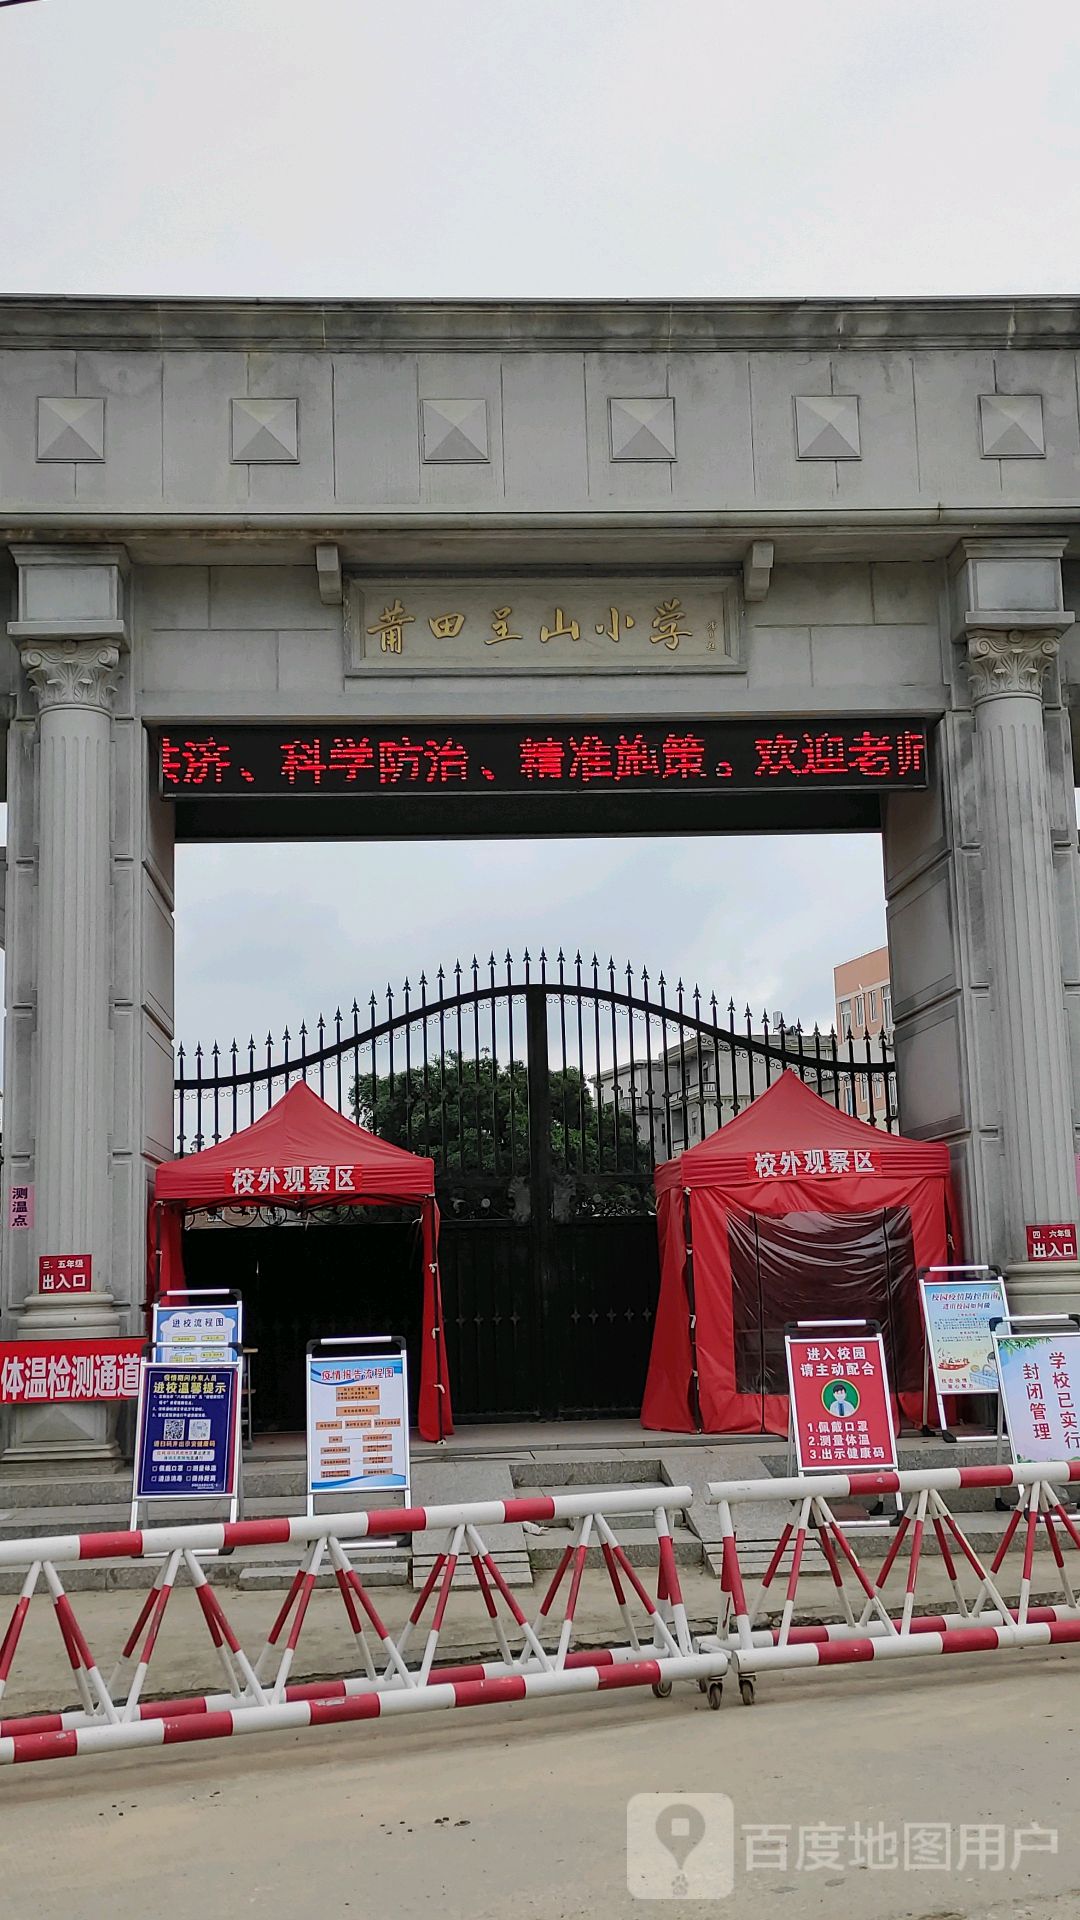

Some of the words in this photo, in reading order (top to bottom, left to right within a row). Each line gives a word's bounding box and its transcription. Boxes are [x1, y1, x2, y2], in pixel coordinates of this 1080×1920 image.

[754, 1149, 875, 1179] 校外观察区
[231, 1165, 356, 1195] 校外观察区
[12, 1187, 28, 1227] 测温点
[1032, 1229, 1072, 1239] 四、六年级
[1032, 1242, 1074, 1258] 出入口
[42, 1259, 85, 1270] 三、五年级
[42, 1273, 86, 1290] 出入口
[172, 1317, 224, 1328] 进校流程图
[806, 1346, 867, 1362] 进入校园
[0, 1352, 141, 1401] 体温检测通道
[321, 1366, 395, 1382] 疫情报告流程图
[800, 1362, 875, 1377] 请主动配合
[153, 1381, 227, 1394] 进校温馨提示
[1022, 1362, 1052, 1440] 封闭管理
[807, 1421, 869, 1433] 1.佩戴口罩
[808, 1433, 871, 1447] 2.测量体温
[809, 1446, 885, 1460] 3.出示健康码
